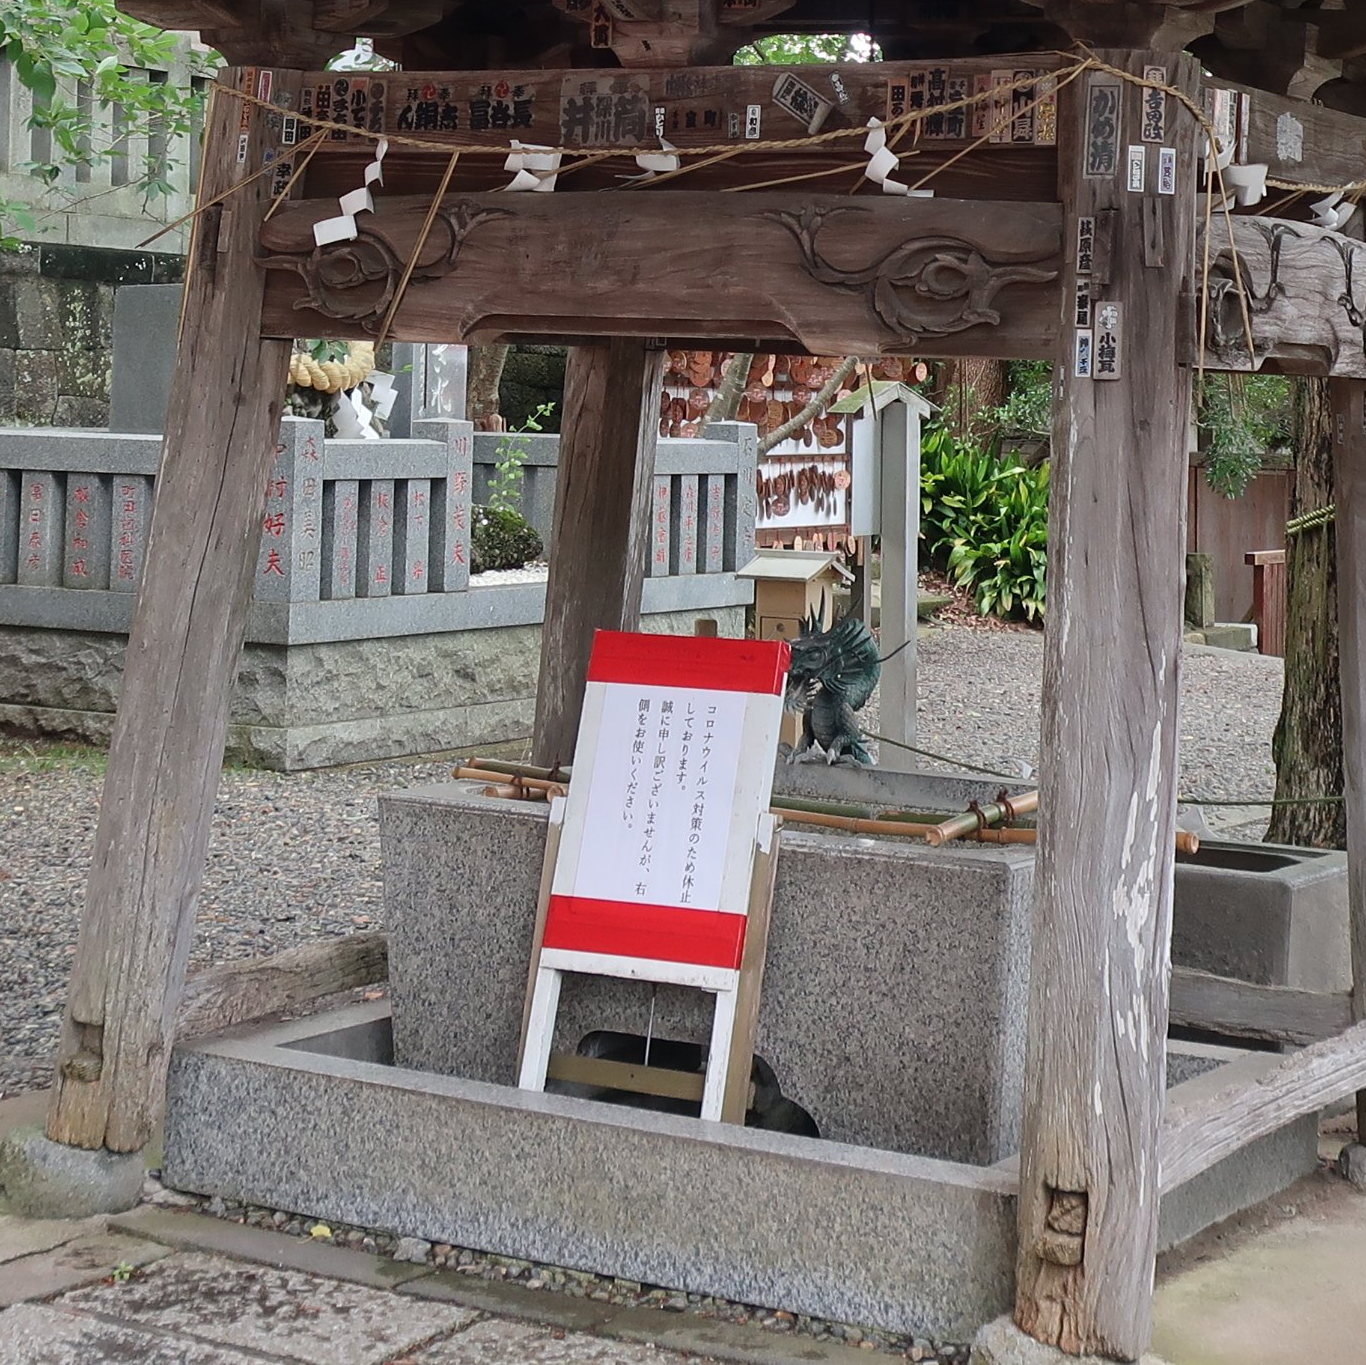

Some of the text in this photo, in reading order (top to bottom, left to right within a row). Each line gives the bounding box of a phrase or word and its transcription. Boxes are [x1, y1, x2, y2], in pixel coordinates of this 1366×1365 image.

[622, 698, 652, 832] 側をお使いください。
[675, 703, 698, 793] しております。
[679, 704, 719, 905] コロナウイルス対策のため休止
